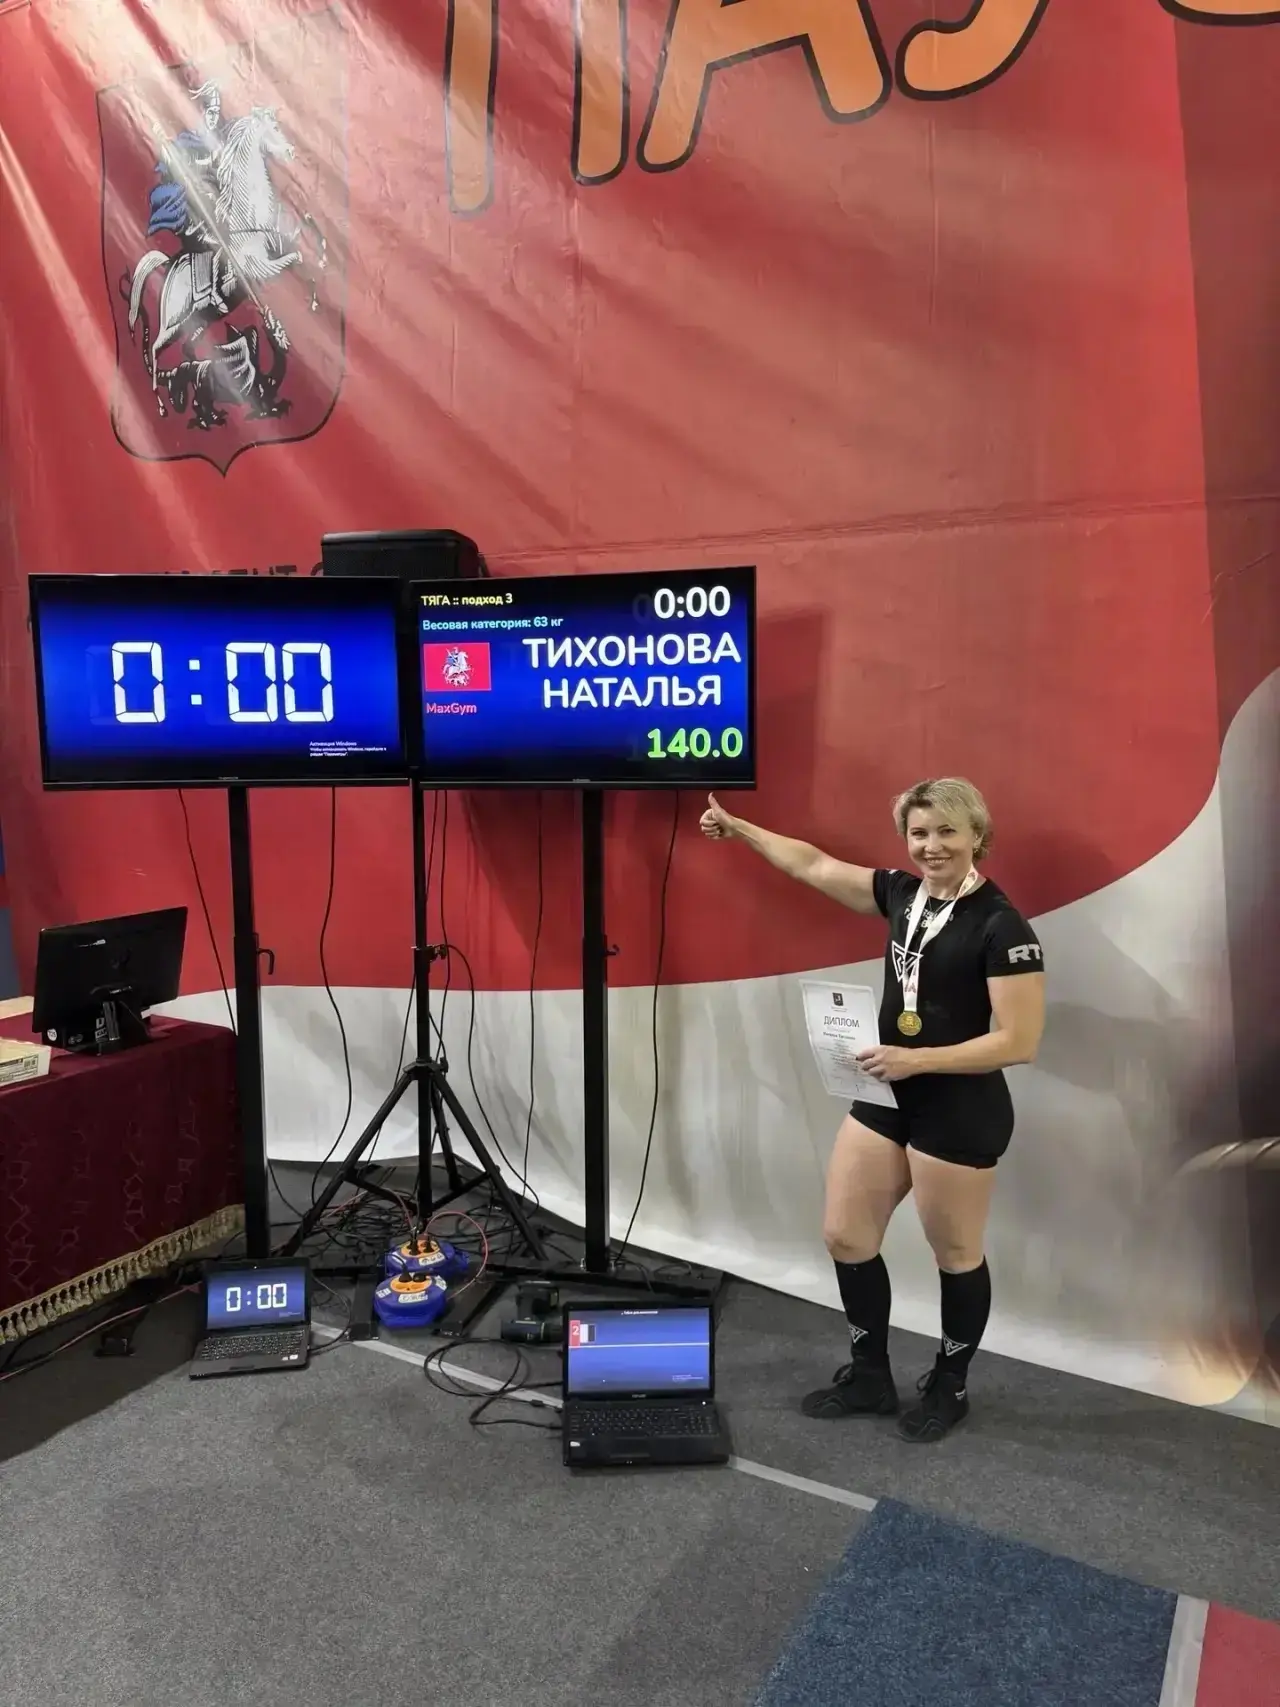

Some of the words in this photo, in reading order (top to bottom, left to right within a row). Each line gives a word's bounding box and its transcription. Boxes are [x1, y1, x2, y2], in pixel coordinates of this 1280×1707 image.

[420, 595, 451, 606] ТЯГА
[461, 595, 504, 606] подход
[505, 593, 513, 604] 3
[653, 585, 732, 619] 0:00
[422, 619, 469, 631] Весовая
[471, 616, 532, 630] категория:
[533, 616, 549, 628] 63
[550, 618, 564, 627] кг
[522, 631, 742, 669] ТИХОНОВА
[111, 641, 335, 724] 0:00
[543, 674, 722, 709] НАТАЛЬЯ
[426, 702, 478, 715] MaxGym
[647, 726, 744, 759] 140.0
[823, 1015, 860, 1028] ДИПЛОМ
[226, 1283, 287, 1312] 0:00
[572, 1325, 580, 1336] 2
